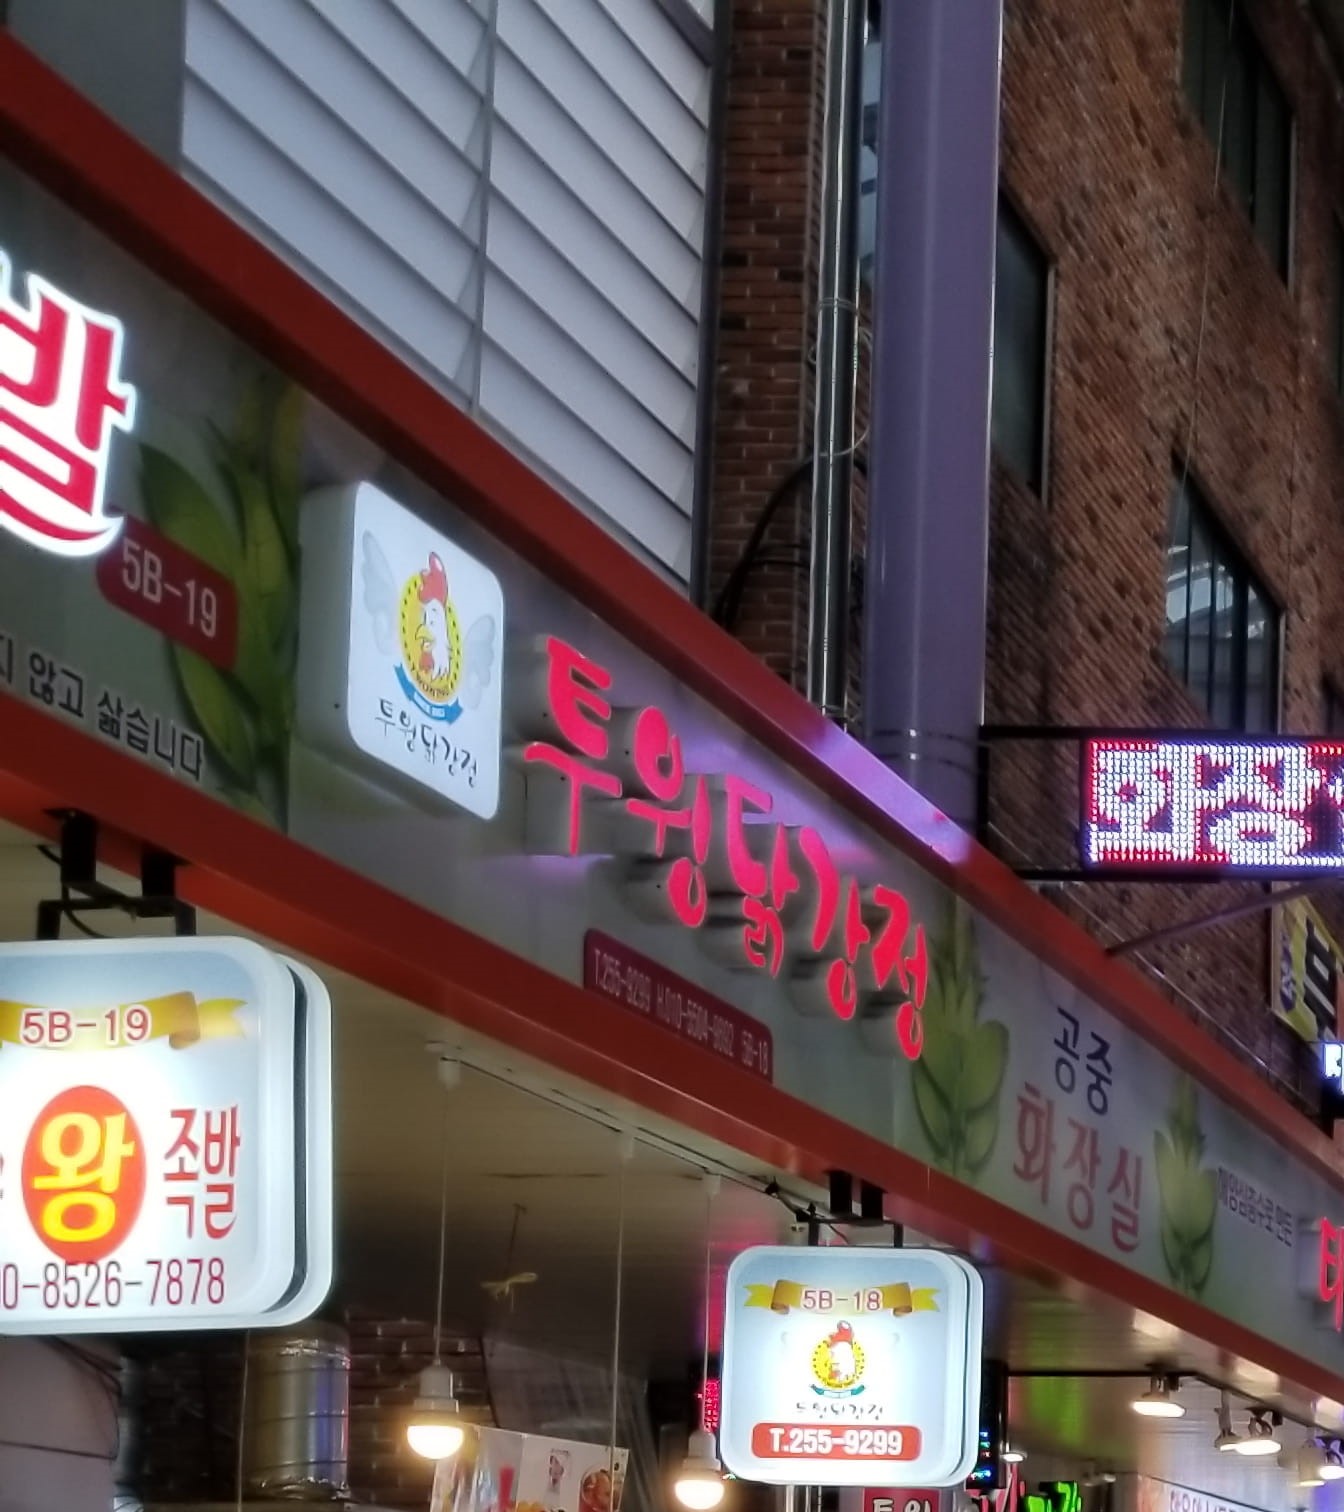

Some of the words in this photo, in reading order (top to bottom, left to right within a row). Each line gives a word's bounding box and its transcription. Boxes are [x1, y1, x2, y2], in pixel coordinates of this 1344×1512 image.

[120, 542, 219, 640] 5B-19
[28, 652, 86, 713] 않고
[97, 687, 205, 779] 삶습니다
[22, 1009, 151, 1044] 5B-19
[1054, 1006, 1113, 1118] 공중
[33, 1110, 135, 1242] 왕
[164, 1104, 240, 1240] 족발
[1013, 1082, 1144, 1254] 화장실
[801, 1289, 883, 1312] 5B-18
[768, 1427, 904, 1456] T.255-9299
